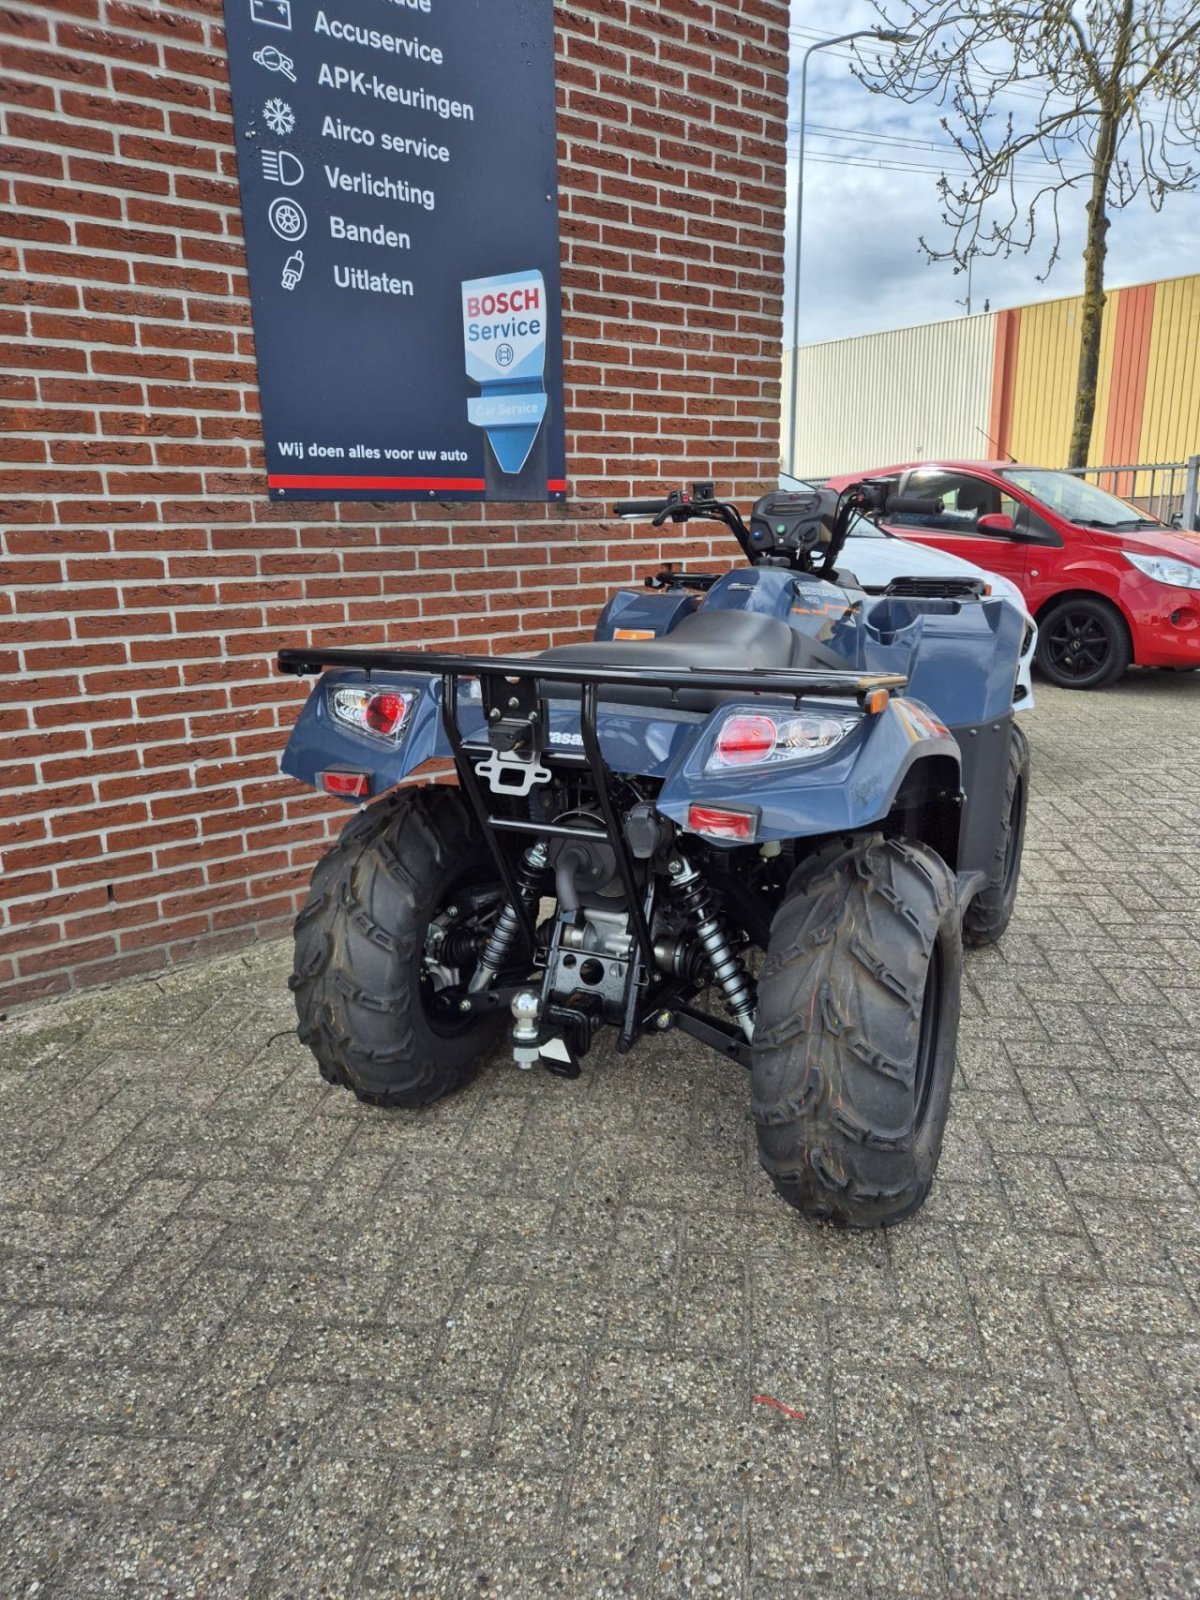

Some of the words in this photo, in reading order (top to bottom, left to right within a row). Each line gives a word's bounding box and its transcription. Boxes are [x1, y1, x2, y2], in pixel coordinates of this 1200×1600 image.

[314, 10, 443, 65] Accuservice
[318, 64, 475, 121] APK-keuringen
[322, 116, 375, 147] Airco
[381, 131, 450, 162] service
[324, 165, 435, 211] Verlichting
[329, 216, 411, 250] Banden
[333, 265, 414, 296] Uitlaten
[467, 288, 539, 318] BOSCH
[468, 317, 541, 342] Service
[476, 404, 495, 417] Car
[498, 401, 539, 416] Service
[278, 442, 304, 459] Wij
[308, 443, 345, 458] doen
[348, 444, 381, 459] alles
[384, 448, 414, 460] voor
[417, 450, 436, 461] uw
[440, 449, 468, 462] auto
